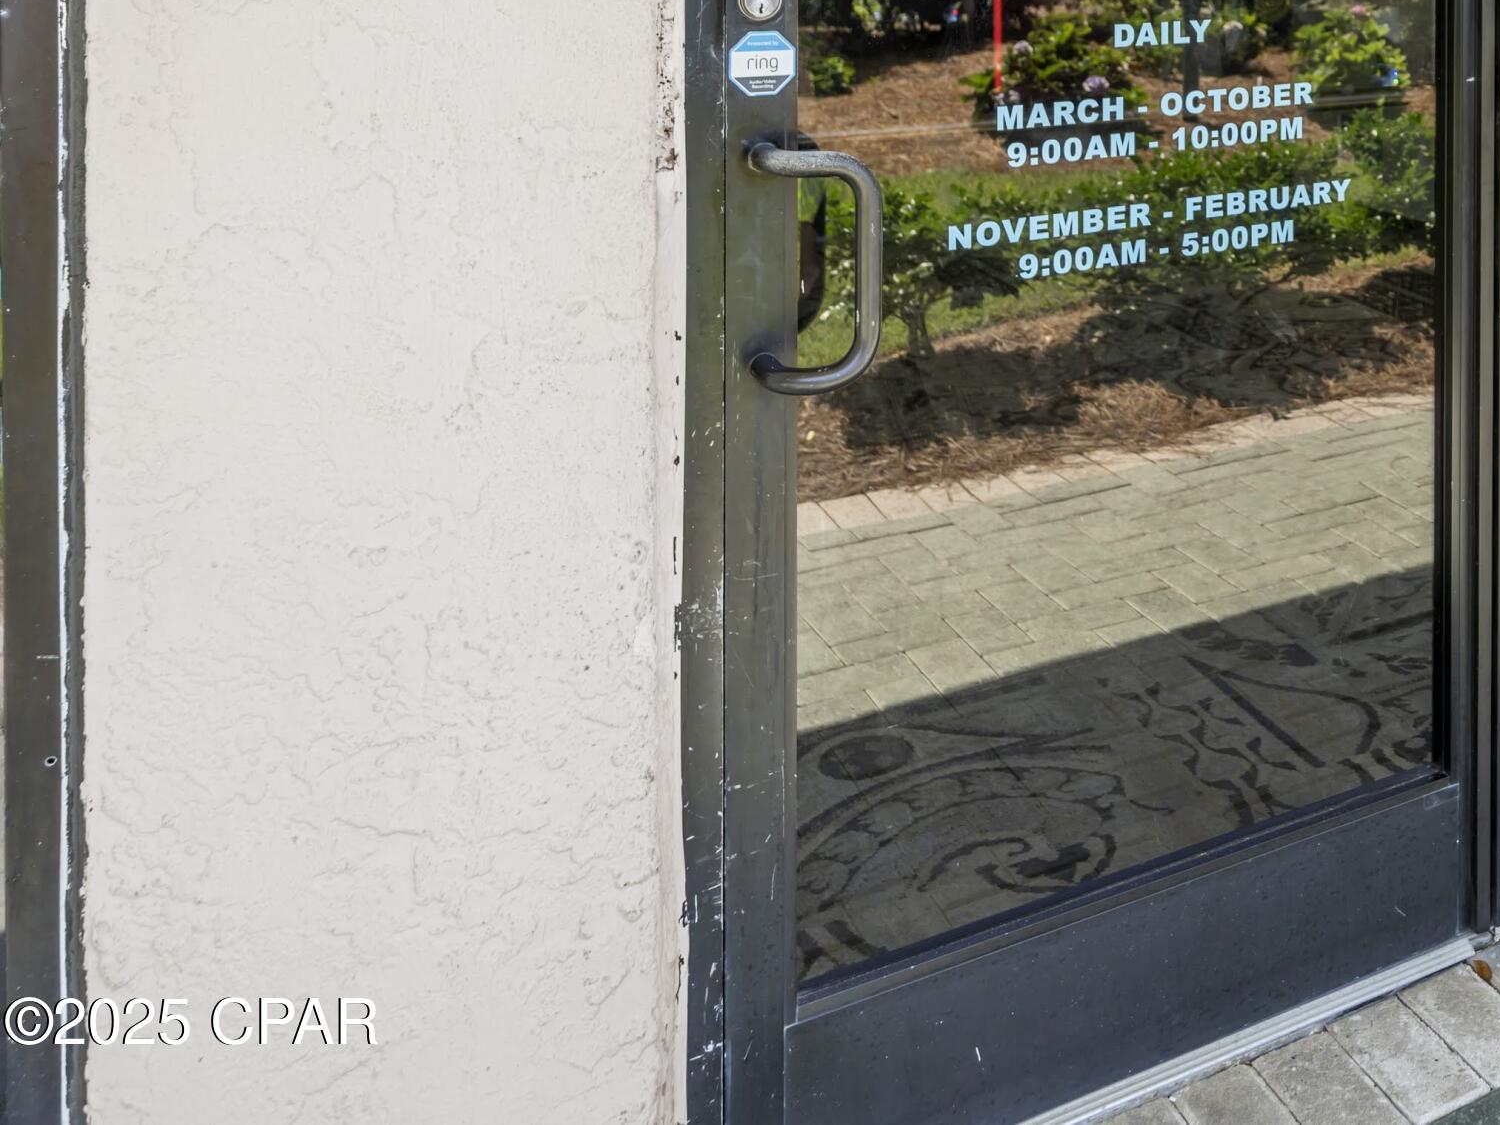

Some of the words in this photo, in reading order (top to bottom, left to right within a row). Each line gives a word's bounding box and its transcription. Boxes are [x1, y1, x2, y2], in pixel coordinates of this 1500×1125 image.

[1113, 19, 1212, 48] DAILY
[747, 54, 779, 73] ring
[996, 96, 1124, 132] MARCH
[1160, 81, 1314, 117] OCTOBER
[1007, 132, 1136, 168] 9:00AM
[1172, 116, 1304, 152] 10:00PM
[947, 203, 1151, 251] NOVEMBER
[1185, 178, 1352, 221] FEBRUARY
[1018, 238, 1147, 279] 9:00AM
[1181, 219, 1295, 258] 5:00PM
